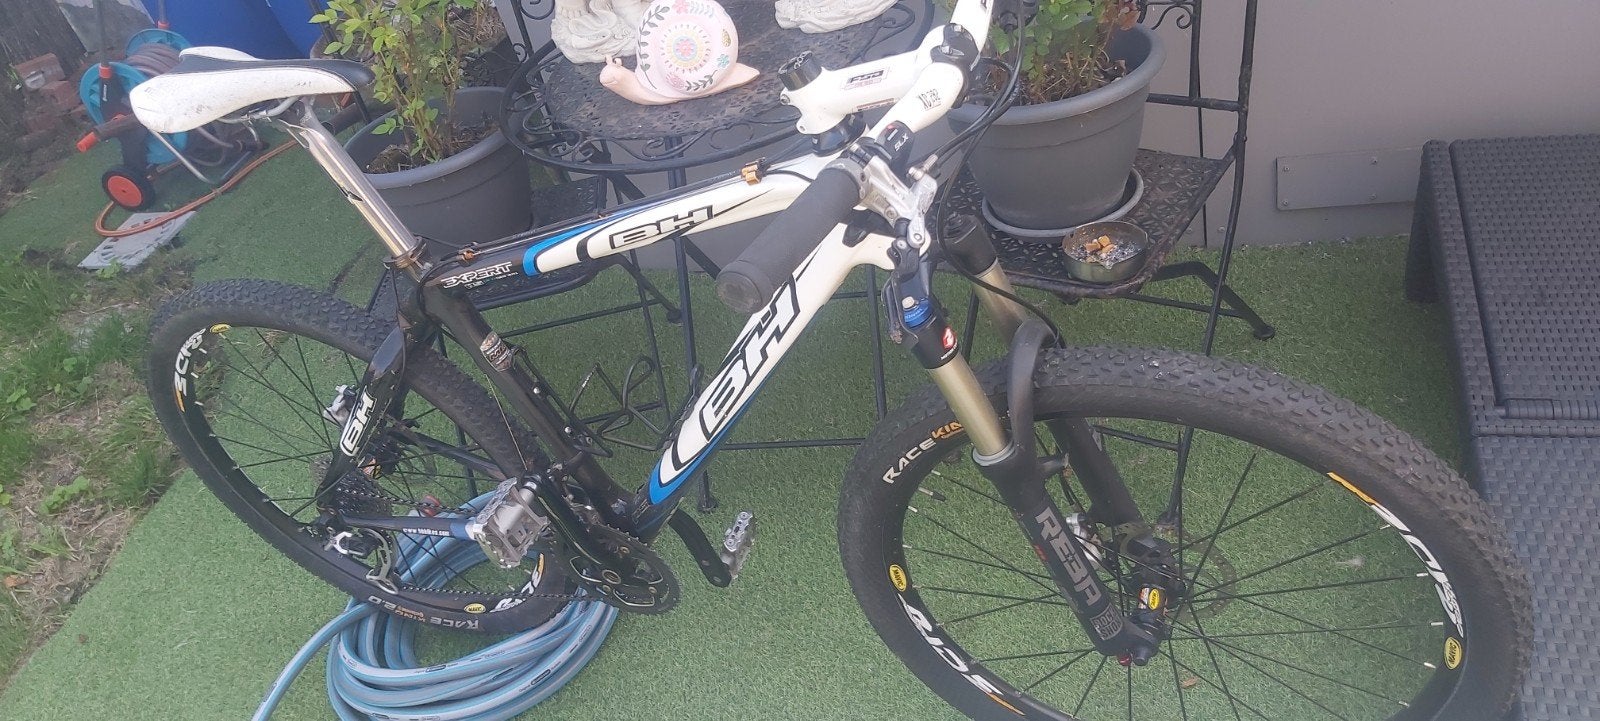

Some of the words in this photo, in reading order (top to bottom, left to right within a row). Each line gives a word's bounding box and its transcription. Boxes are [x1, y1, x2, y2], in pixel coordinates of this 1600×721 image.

[894, 133, 909, 152] SLX
[609, 205, 714, 250] BH
[440, 261, 513, 289] EXPERT
[699, 273, 801, 443] BH
[341, 387, 377, 456] BH
[882, 437, 937, 485] RACE
[931, 421, 964, 440] KIN
[1034, 506, 1102, 607] REBA
[430, 616, 480, 631] RACE
